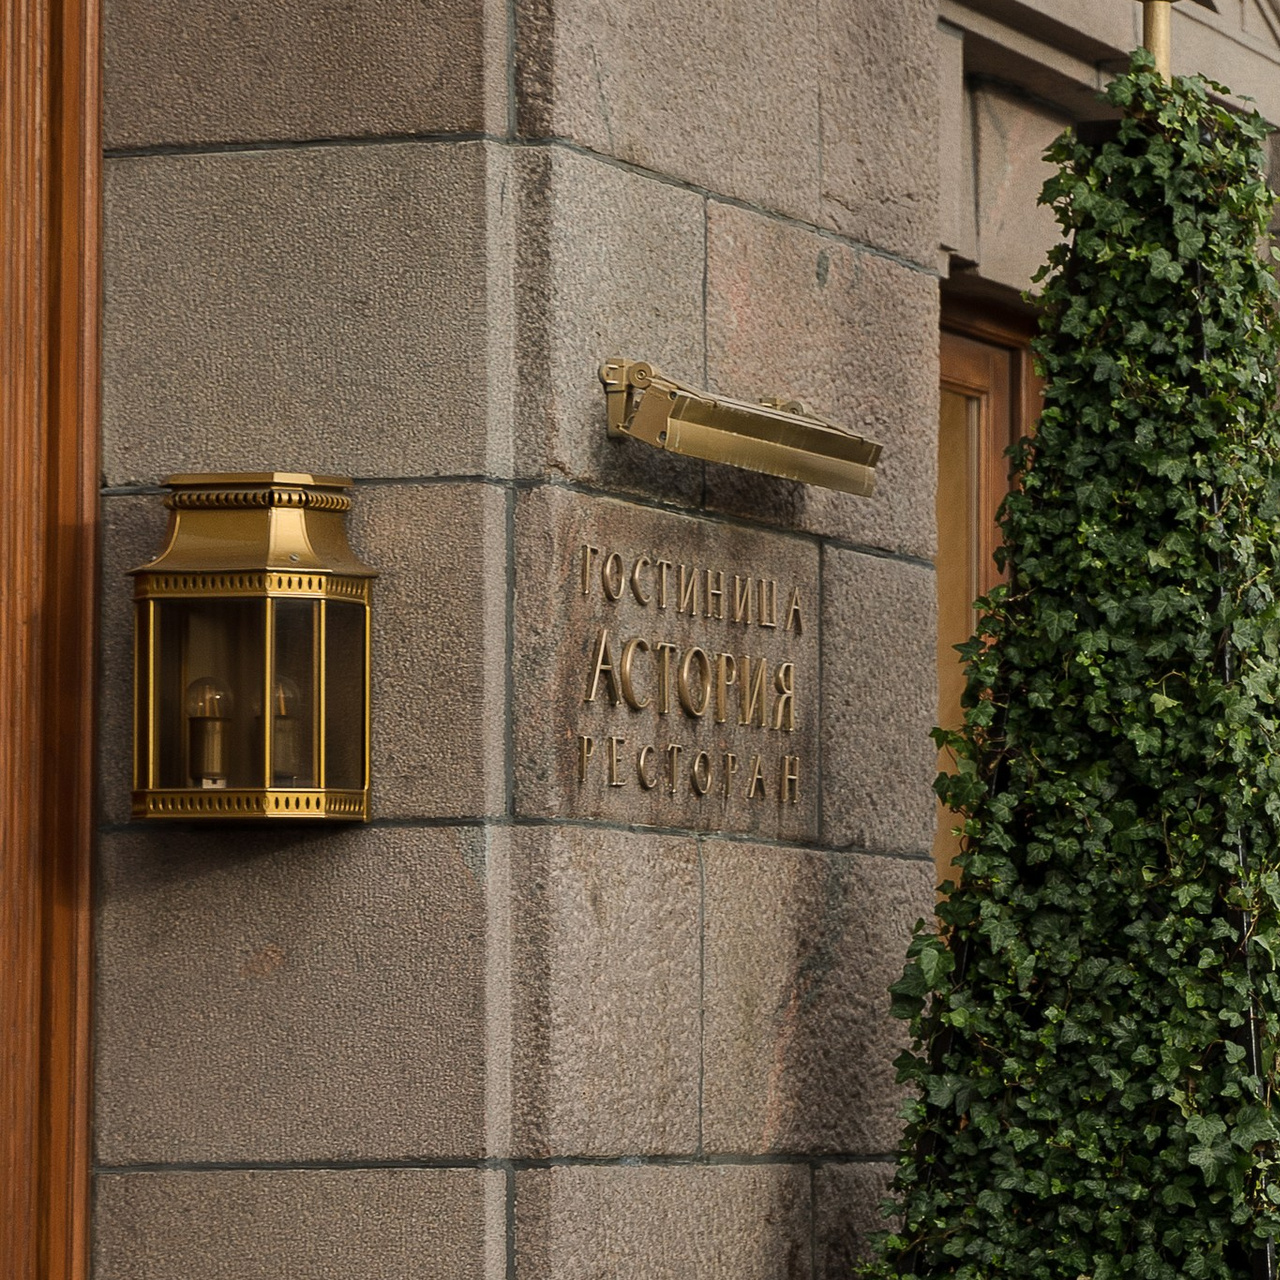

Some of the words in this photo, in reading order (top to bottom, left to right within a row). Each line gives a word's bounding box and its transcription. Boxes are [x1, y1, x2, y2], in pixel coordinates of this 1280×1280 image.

[582, 544, 803, 635] ГОСТИНИЦА
[583, 629, 795, 732] АСТОРИЯ
[579, 735, 801, 804] РЕСТОРАН
